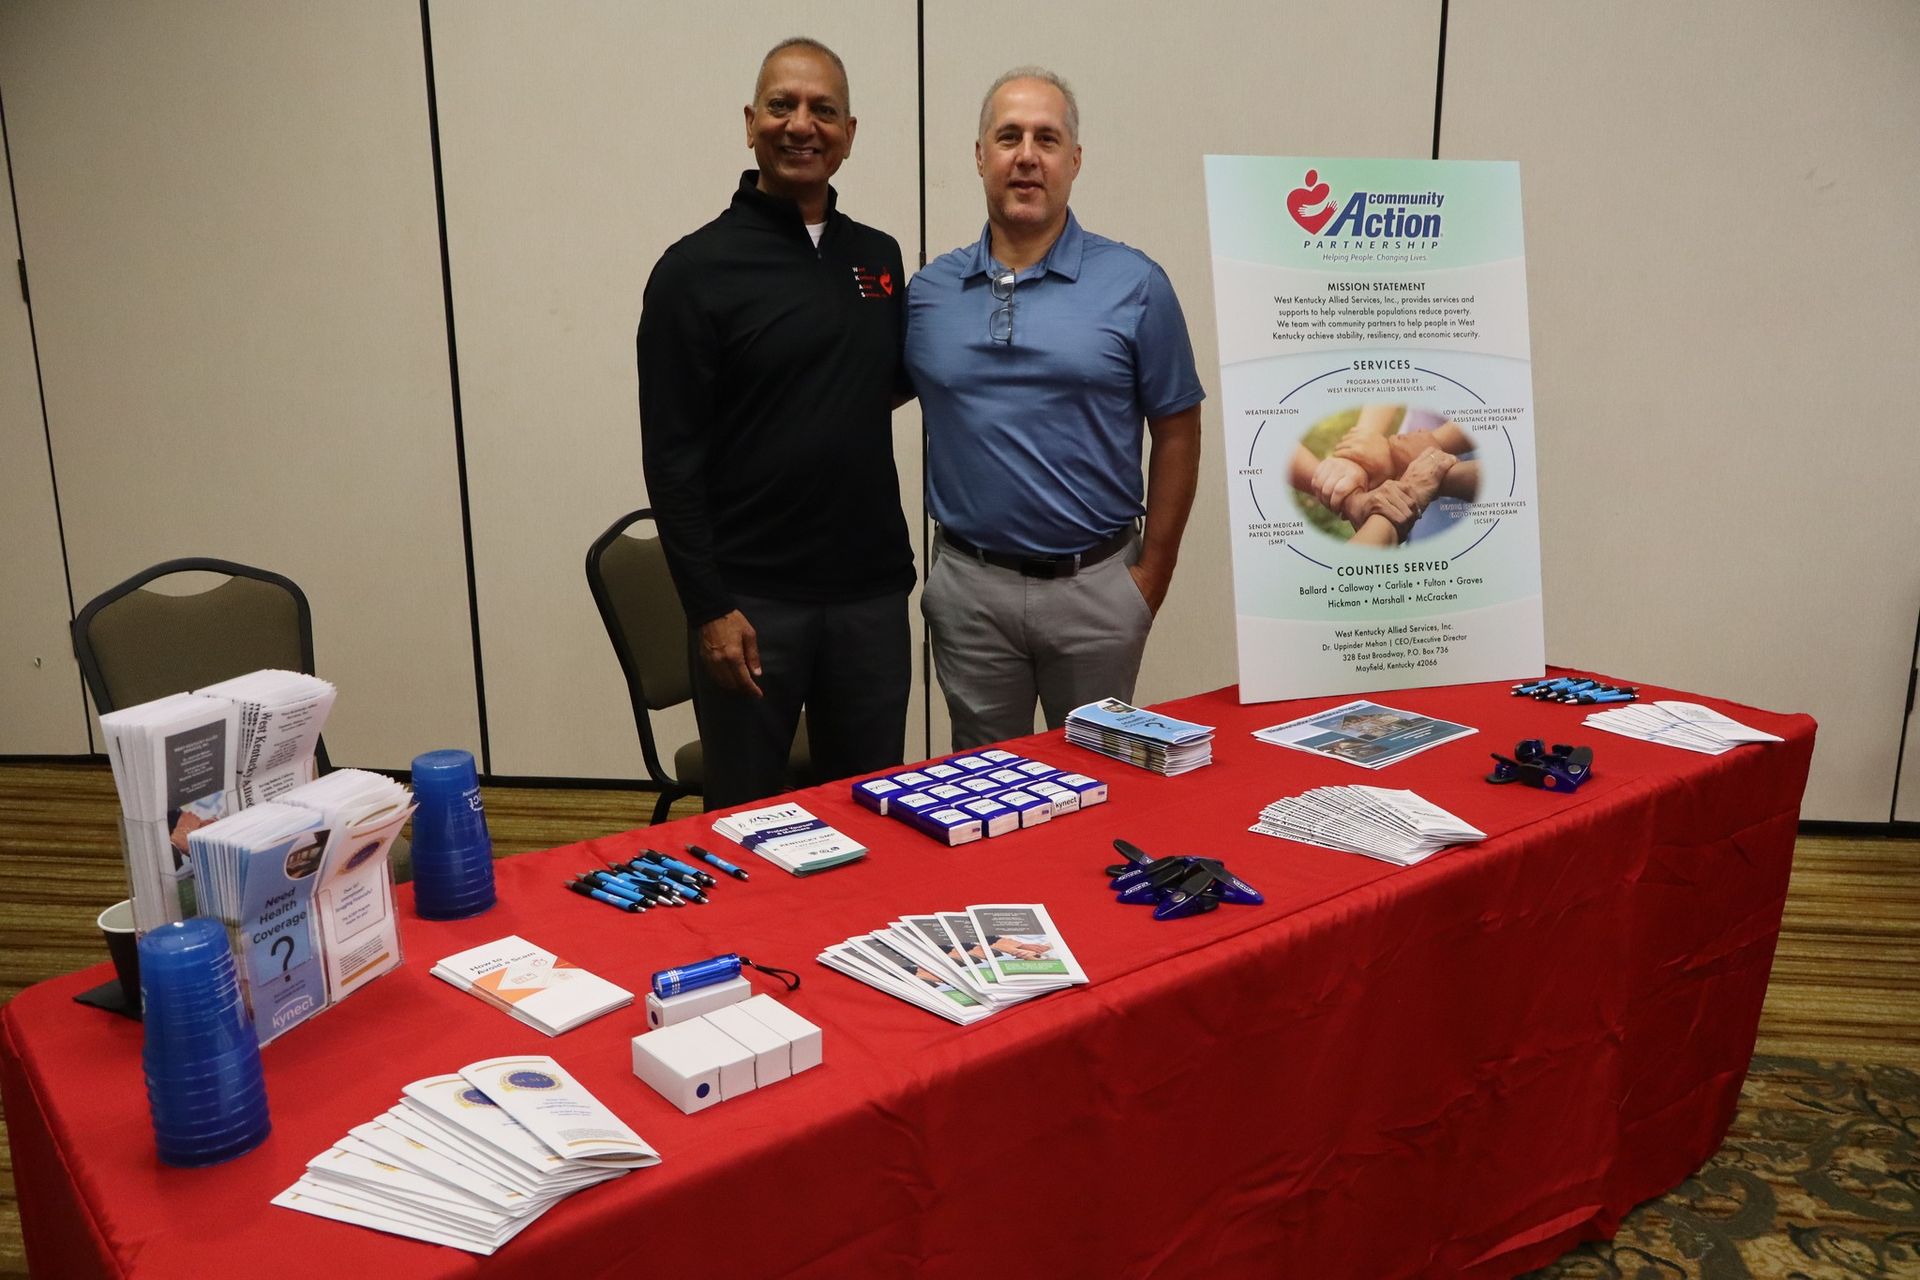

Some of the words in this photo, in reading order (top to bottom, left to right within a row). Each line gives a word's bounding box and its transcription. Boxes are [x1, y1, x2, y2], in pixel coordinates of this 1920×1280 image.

[1368, 192, 1444, 207] community
[1324, 192, 1441, 238] Action
[1303, 241, 1439, 249] PARTNERSHIP
[1323, 254, 1349, 262] Helping
[1376, 254, 1409, 262] Changing
[1327, 282, 1370, 291] MISSION
[1373, 282, 1426, 291] STATEMENT
[1274, 296, 1292, 304] West
[1294, 296, 1326, 306] Kentucky
[1328, 295, 1349, 304] Allied
[1351, 295, 1382, 305] Services,
[1401, 295, 1431, 305] provides
[1433, 296, 1459, 304] services
[1461, 295, 1475, 303] and
[1279, 309, 1309, 318] supports
[1311, 308, 1319, 316] to
[1320, 308, 1336, 318] help
[1338, 307, 1375, 316] vulnerable
[1376, 307, 1417, 317] populations
[1419, 307, 1442, 315] reduce
[1277, 320, 1290, 328] We
[1311, 320, 1327, 328] with
[1328, 320, 1366, 329] community
[1367, 320, 1397, 329] partners
[1407, 319, 1423, 328] help
[1424, 319, 1448, 328] people
[1449, 319, 1457, 327] in
[1458, 319, 1475, 327] West
[1272, 332, 1305, 342] Kentucky
[1307, 332, 1335, 340] achieve
[1336, 331, 1365, 341] stability,
[1367, 331, 1401, 341] resiliency,
[1403, 331, 1417, 339] and
[1418, 331, 1451, 339] economic
[1353, 359, 1411, 370] SERVICES
[1245, 408, 1299, 416] WEATHERIZATION
[1239, 468, 1263, 476] KYNECT
[1273, 521, 1304, 529] MEDICARE
[1337, 563, 1399, 577] COUNTIES
[1404, 560, 1449, 573] SERVED
[1299, 585, 1328, 596] Ballard
[1338, 583, 1374, 594] Calloway
[1385, 579, 1413, 590] Carlisle
[1423, 578, 1447, 587] Fulton
[1456, 576, 1483, 585] Graves
[1328, 598, 1361, 608] Hickman
[1372, 595, 1405, 605] Marshall
[1416, 592, 1458, 603] McCracken
[1335, 630, 1353, 638] West
[1354, 627, 1385, 637] Kentucky
[1388, 625, 1408, 634] Allied
[1409, 624, 1439, 633] Services,
[1441, 623, 1454, 631] Inc.
[1334, 641, 1363, 652] Uppinder
[1365, 639, 1388, 648] Mehan
[1394, 636, 1441, 646] CEO/Executive
[1443, 634, 1467, 642] Director
[1342, 654, 1356, 662] 328
[1372, 650, 1406, 660] Broadway,
[1422, 647, 1434, 655] Box
[1436, 646, 1449, 654] 736
[1356, 663, 1385, 673] Mayfield,
[1387, 660, 1415, 670] Kentucky
[1416, 659, 1437, 667] 42066
[257, 712, 273, 734] West
[242, 735, 267, 778] Kentucky
[1055, 796, 1077, 809] kynect
[265, 887, 296, 909] Need
[259, 900, 297, 925] Health
[253, 911, 307, 945] Coverage
[270, 935, 295, 983] ?
[272, 996, 315, 1029] kynect
